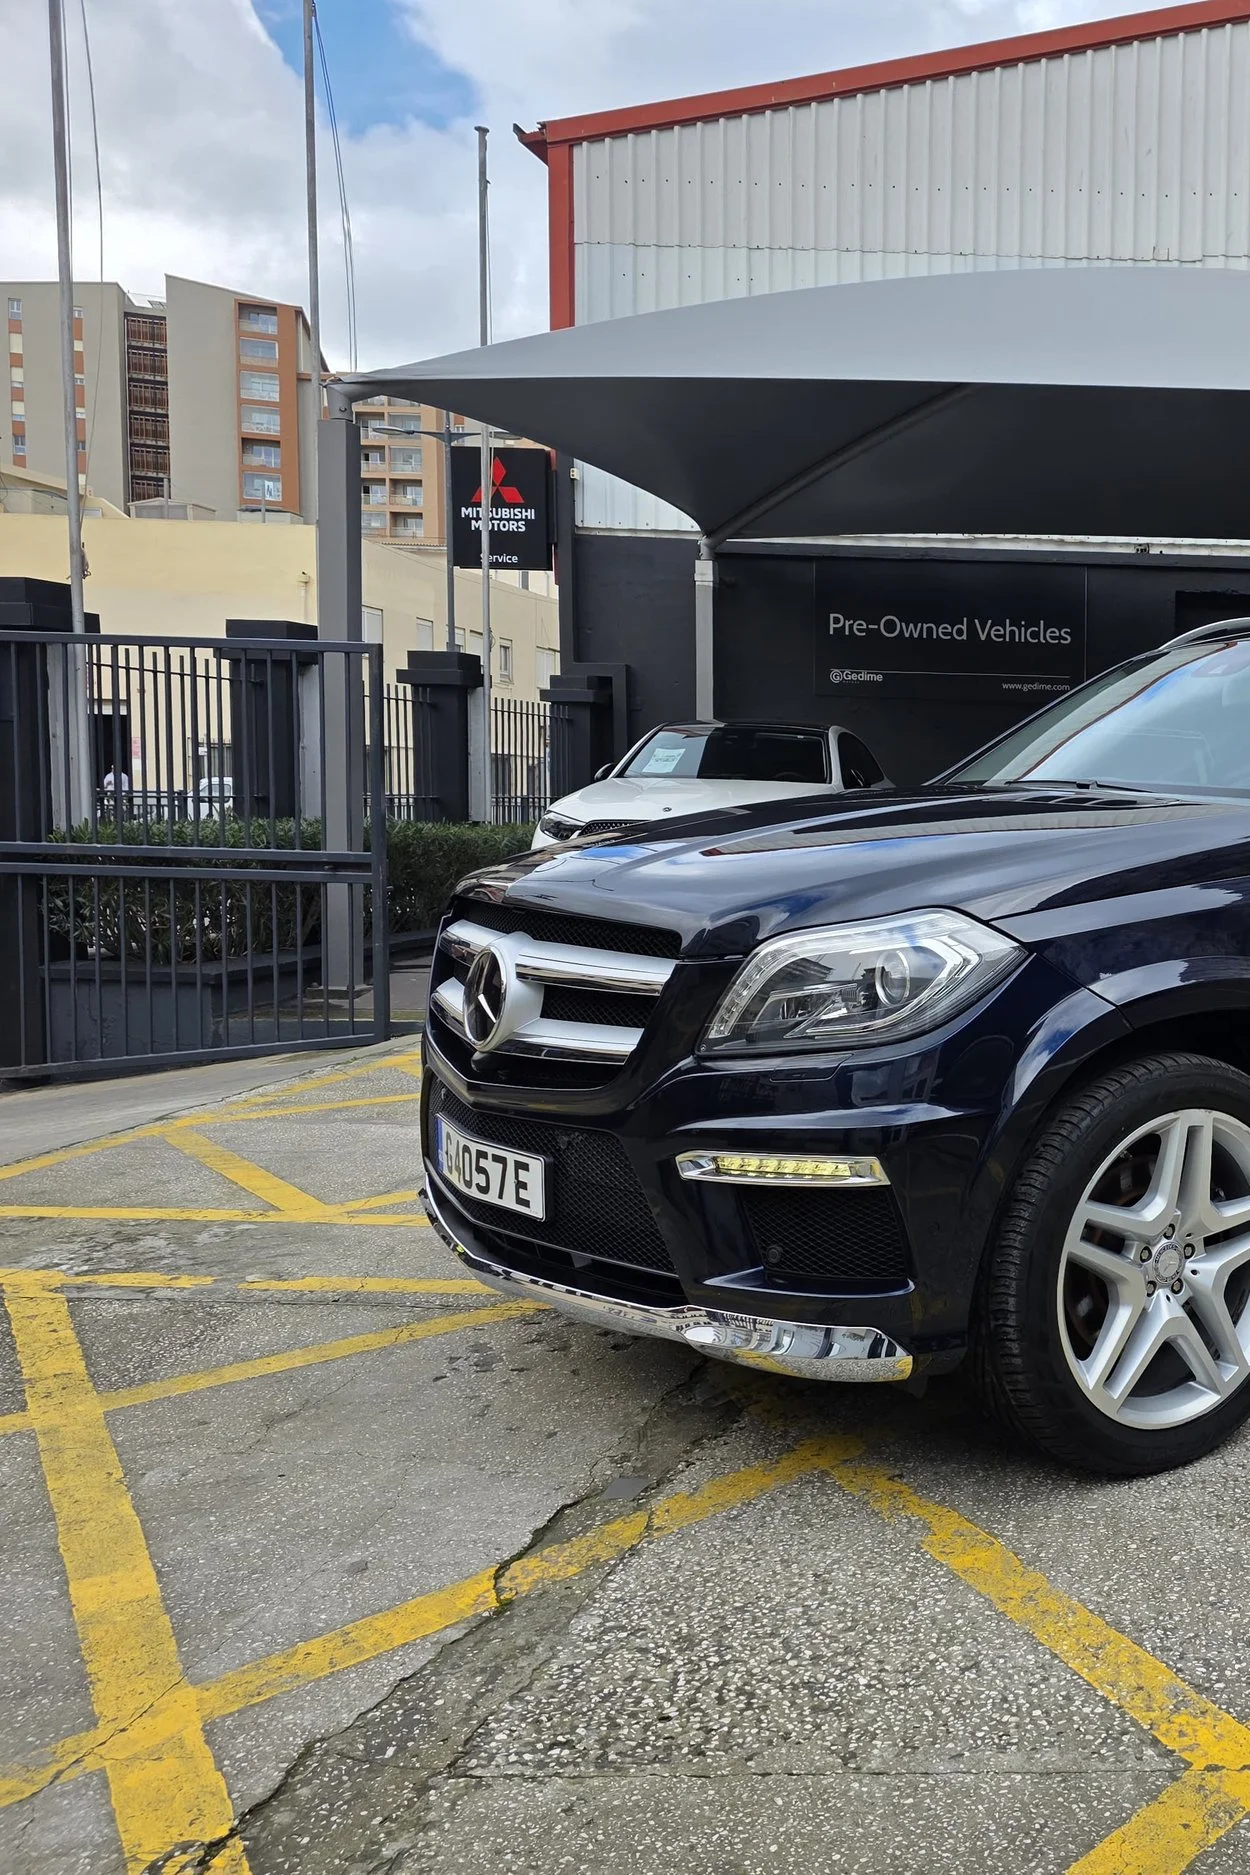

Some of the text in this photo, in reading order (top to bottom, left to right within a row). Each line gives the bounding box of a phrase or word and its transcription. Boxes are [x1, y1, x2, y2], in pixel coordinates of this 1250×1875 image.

[829, 613, 1072, 644] Pre-Owned Vehicles
[843, 670, 883, 682] Gedime
[1002, 682, 1071, 692] www.gedime.com
